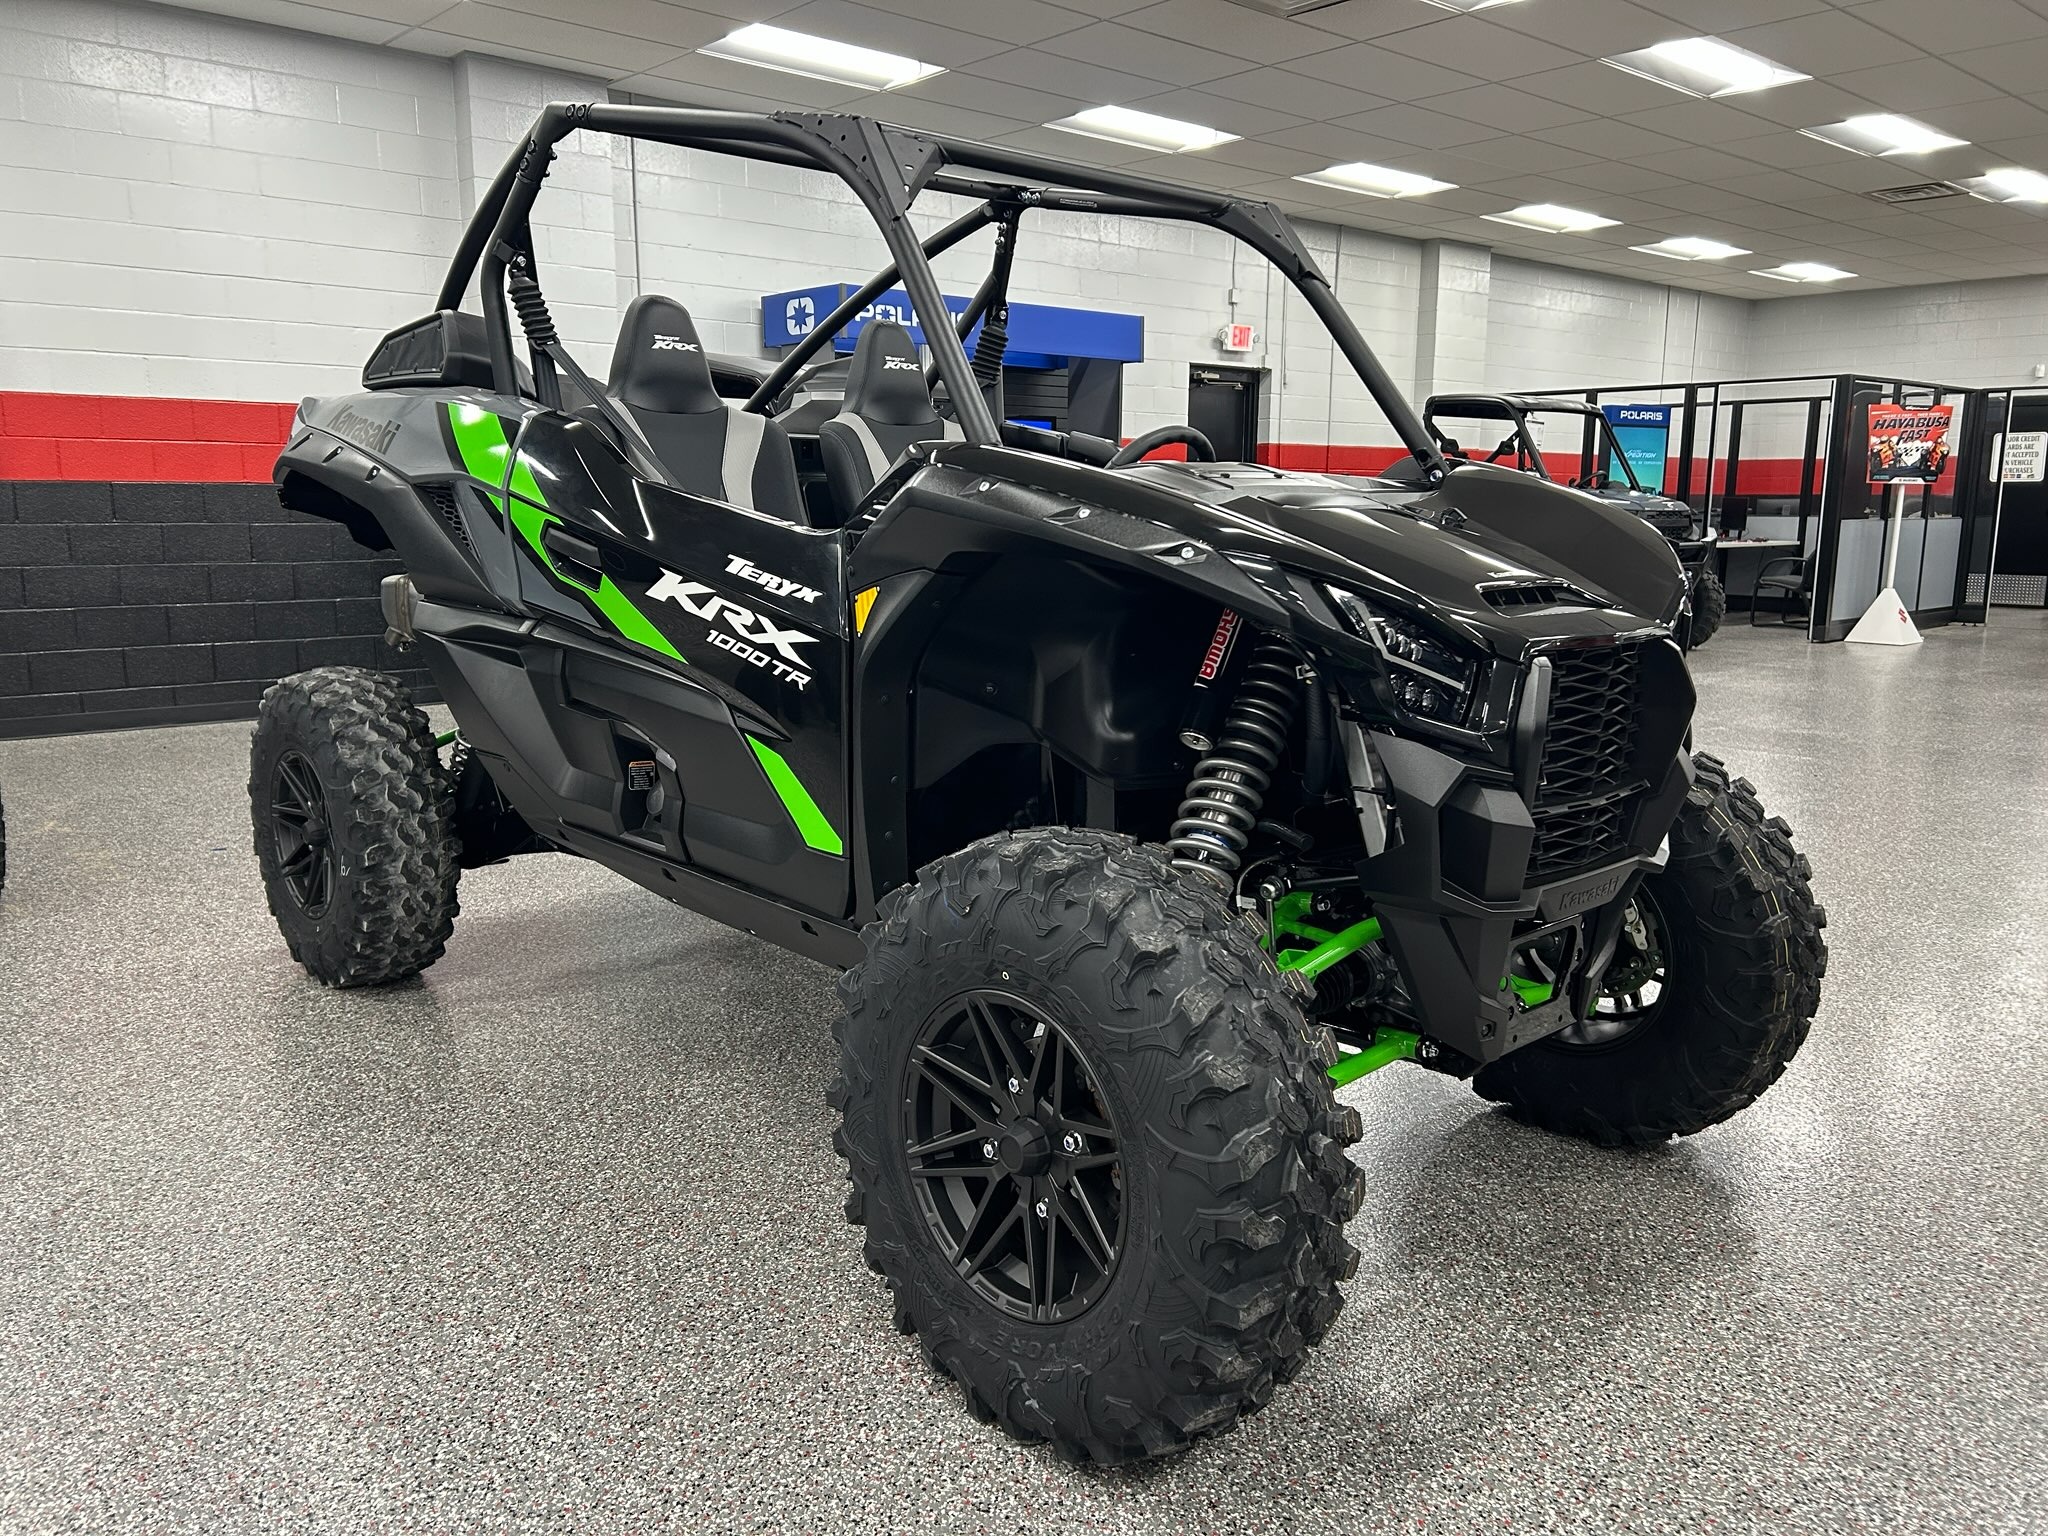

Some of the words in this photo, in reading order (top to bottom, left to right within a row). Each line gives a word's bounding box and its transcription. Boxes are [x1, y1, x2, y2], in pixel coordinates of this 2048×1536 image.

[1232, 325, 1251, 348] EXIT
[651, 340, 699, 352] KRX
[883, 361, 920, 371] KRX
[1620, 410, 1663, 421] POLARIS
[1872, 415, 1950, 430] HAYABUSA
[326, 403, 402, 455] Kawasaki
[1896, 429, 1932, 446] FAST
[2020, 435, 2041, 443] CREDIT
[724, 554, 825, 604] TERYX
[644, 566, 821, 670] KRX
[1559, 875, 1620, 911] Kawasaki
